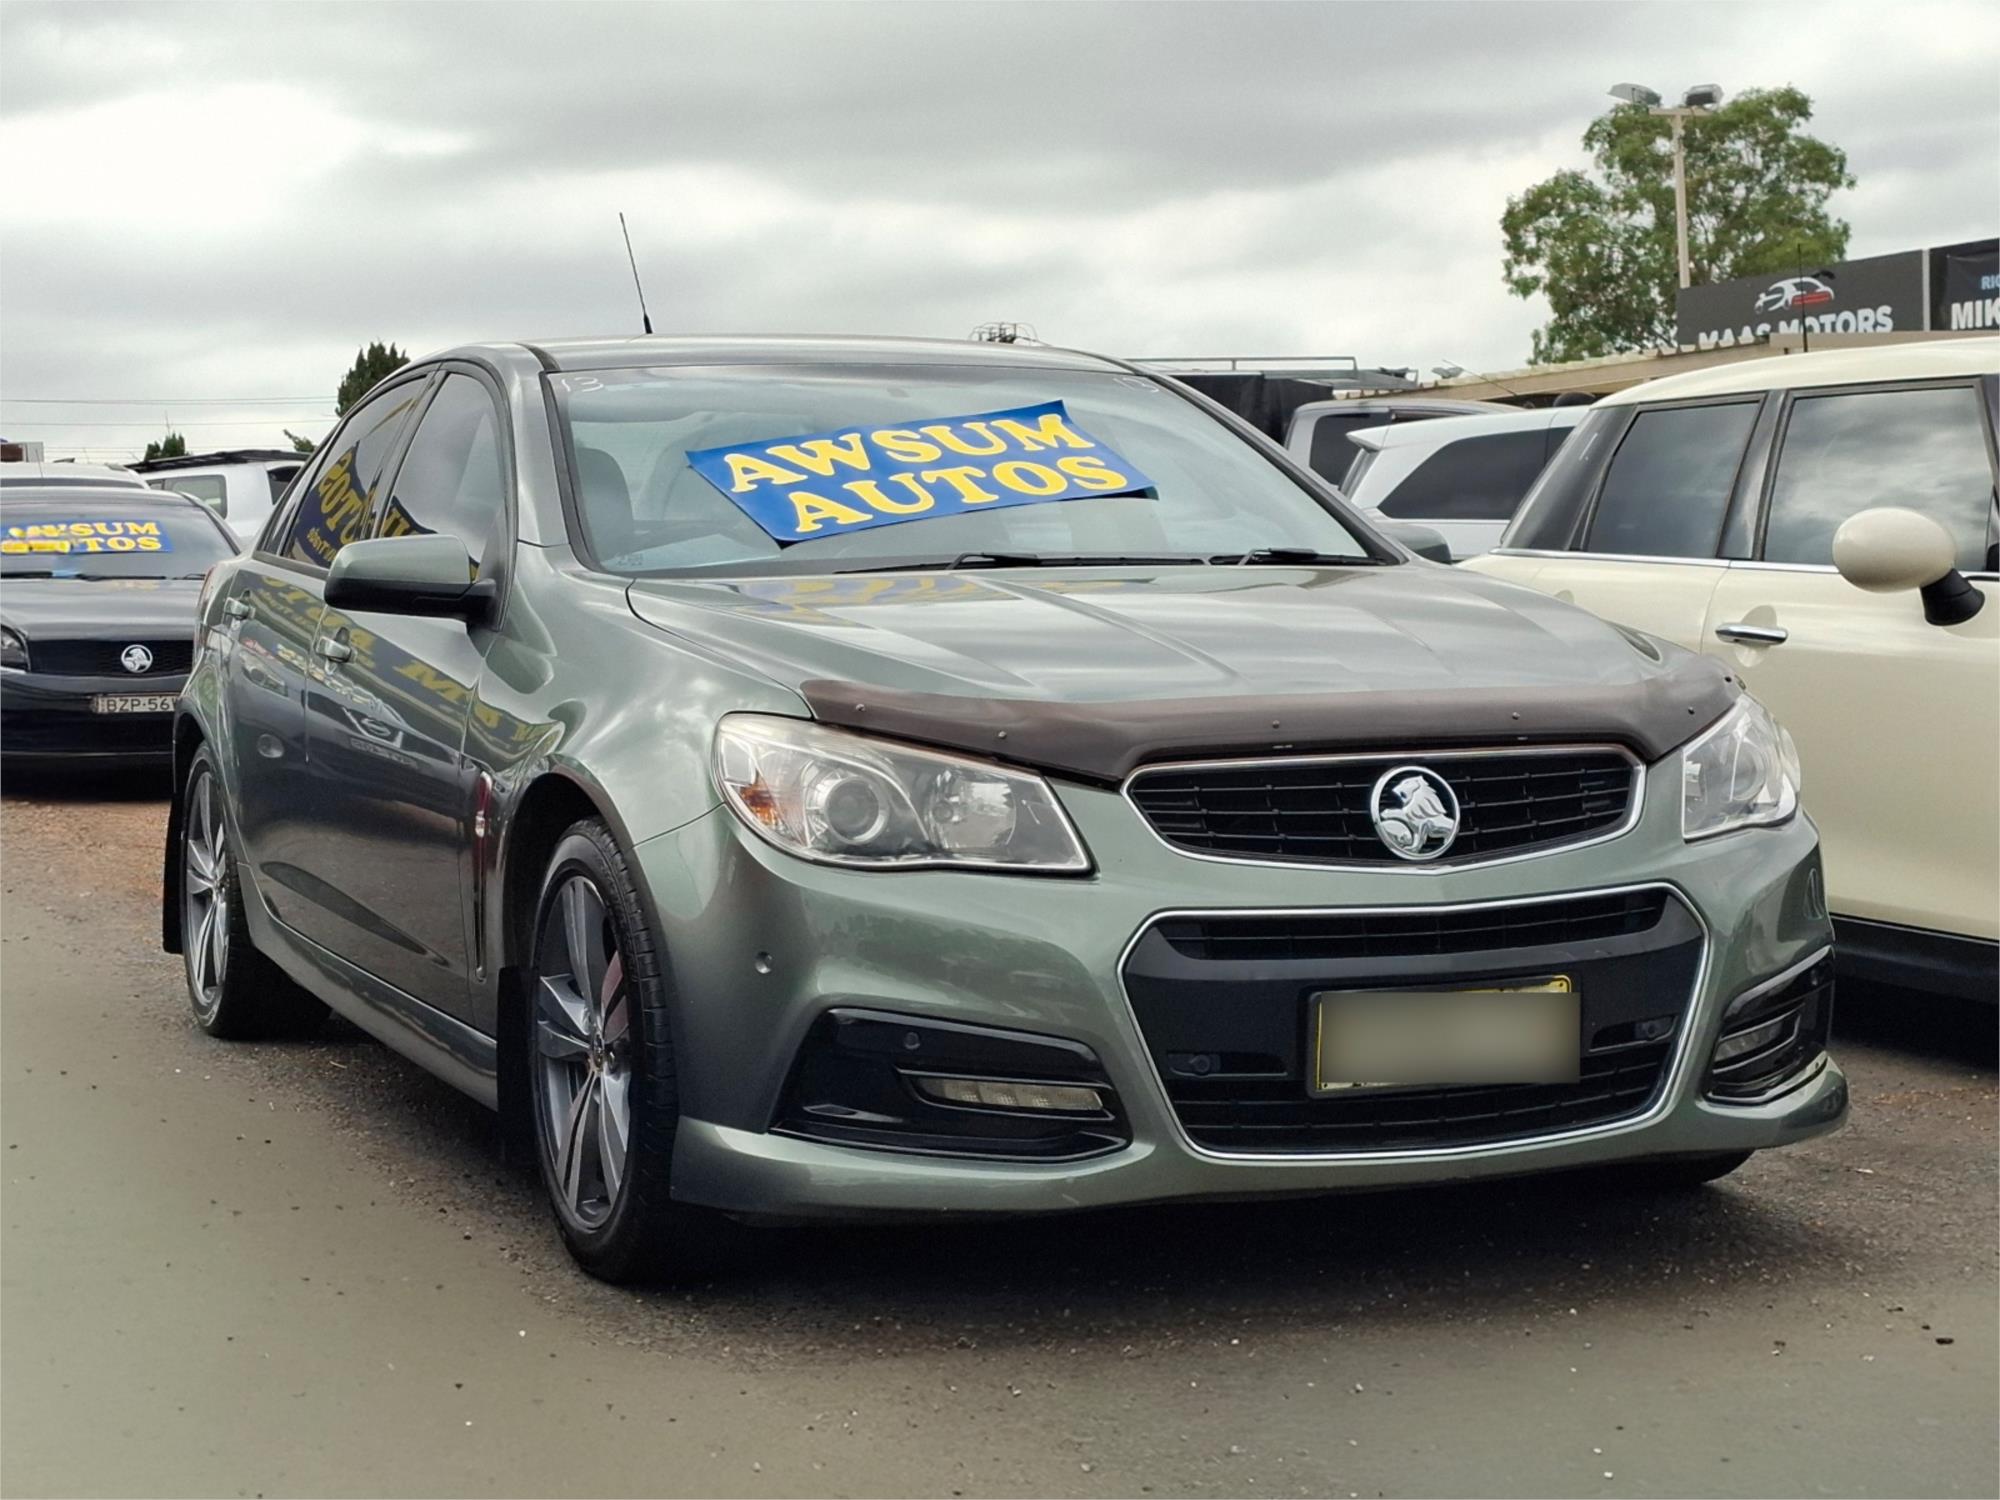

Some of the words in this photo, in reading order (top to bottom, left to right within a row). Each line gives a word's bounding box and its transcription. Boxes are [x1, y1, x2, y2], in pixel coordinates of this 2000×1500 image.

[1778, 305, 1895, 334] MOTORS
[724, 413, 1096, 493] AWSUM
[787, 456, 1128, 533] AUTOS
[1, 536, 162, 553] TOS
[8, 522, 161, 538] SUM
